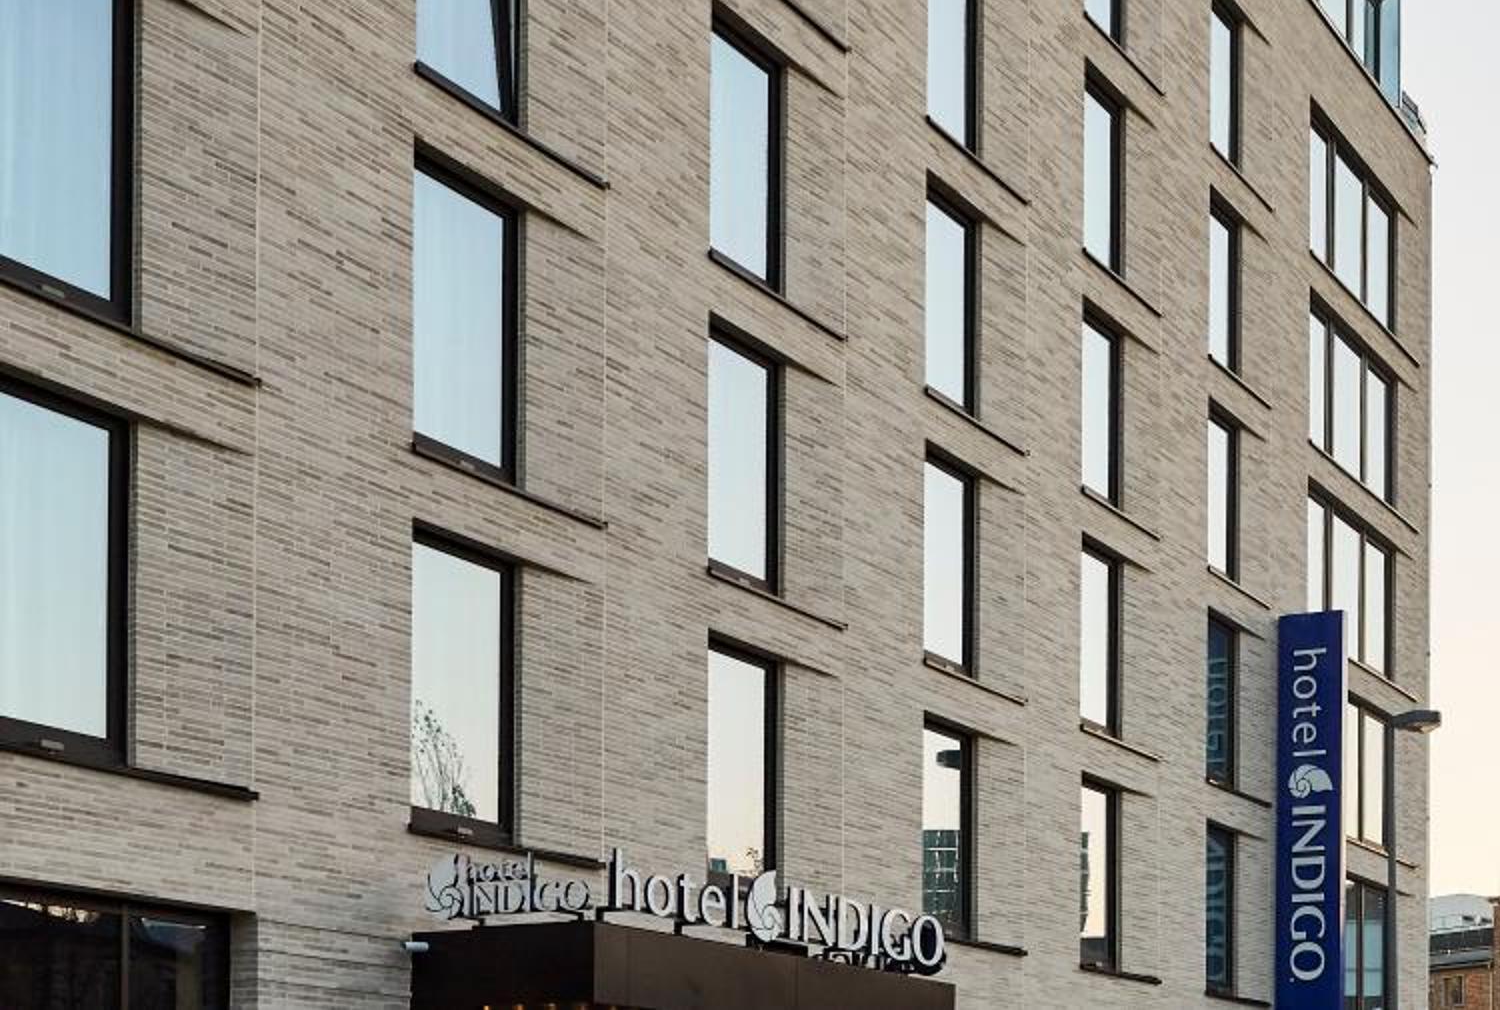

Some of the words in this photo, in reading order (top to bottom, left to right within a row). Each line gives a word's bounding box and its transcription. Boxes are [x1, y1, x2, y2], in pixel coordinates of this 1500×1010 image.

[1292, 647, 1327, 757] hotel
[613, 847, 740, 930] hotel
[788, 887, 944, 967] INDIGO
[1289, 805, 1327, 981] INDIGO
